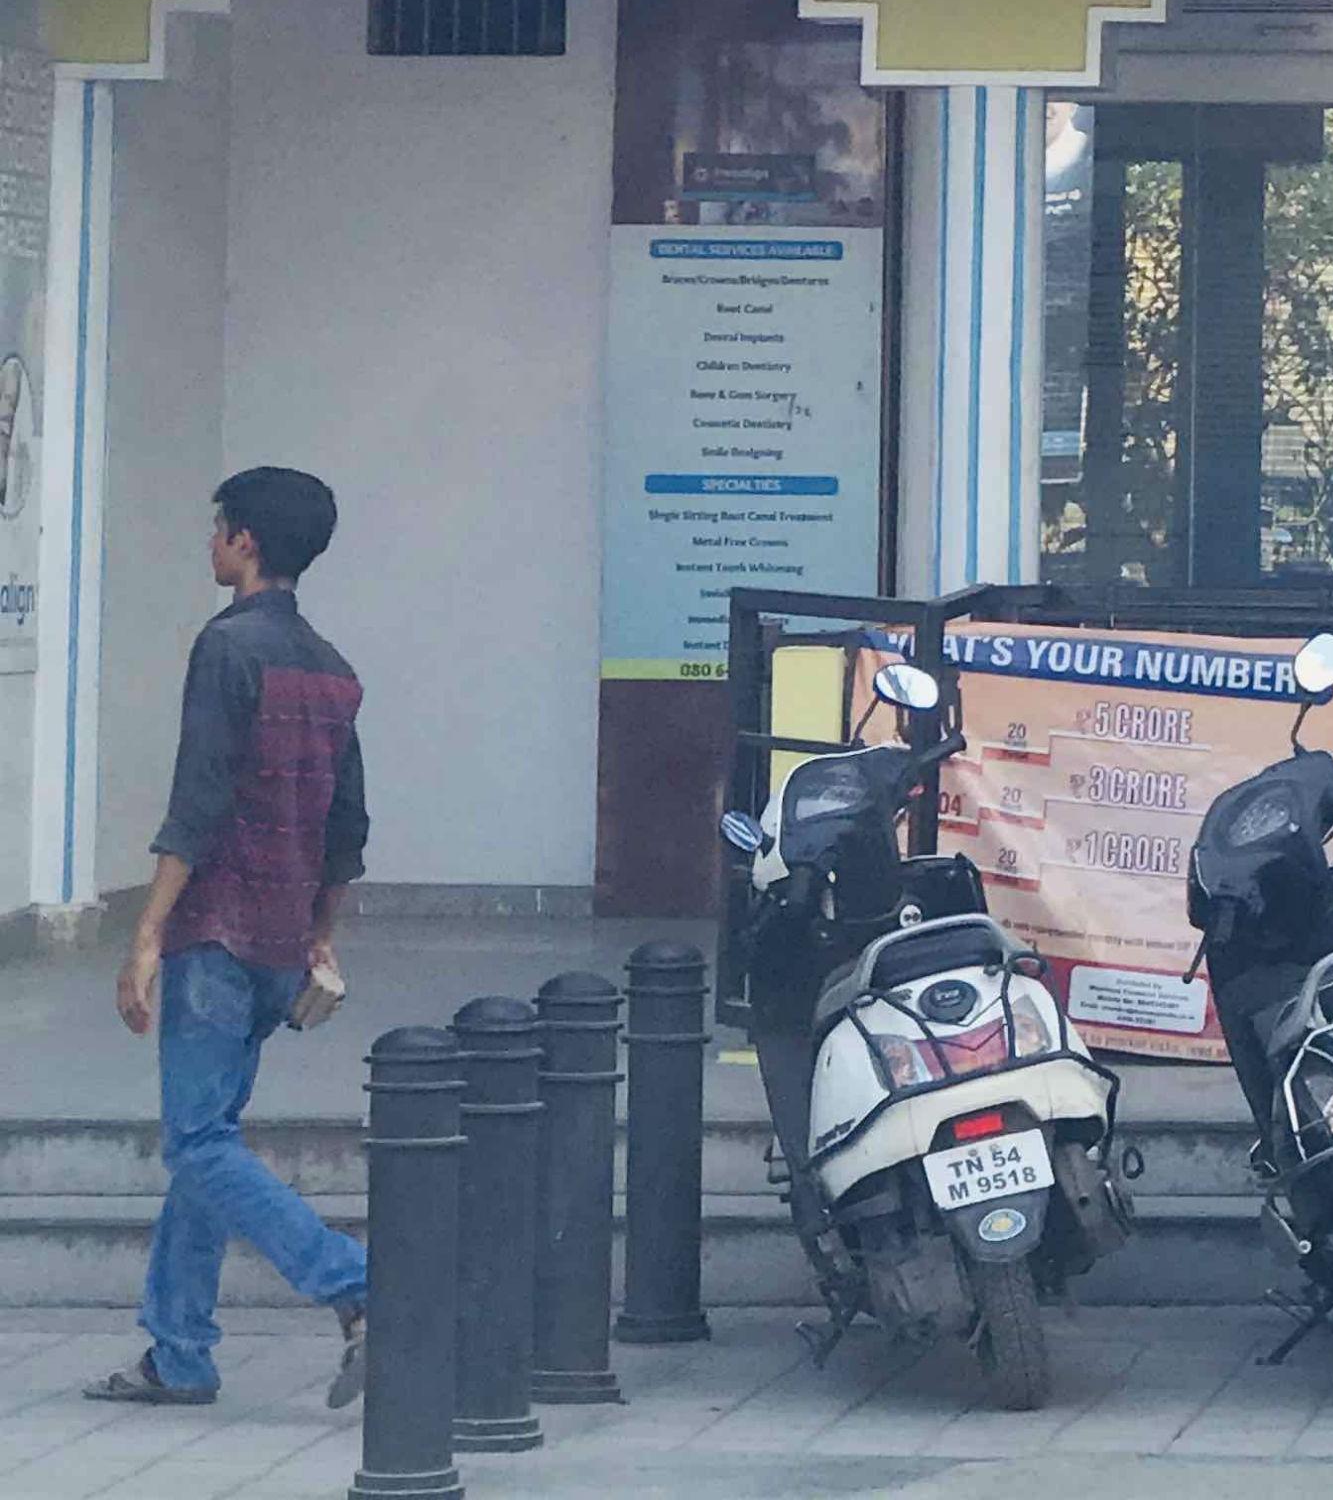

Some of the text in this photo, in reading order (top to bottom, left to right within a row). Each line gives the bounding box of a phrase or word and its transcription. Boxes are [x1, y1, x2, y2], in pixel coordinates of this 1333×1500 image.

[1027, 639, 1123, 679] YOUR
[1135, 649, 1297, 695] NUMBER
[1007, 722, 1027, 739] 20
[1095, 702, 1194, 744] 5 CRORE
[1002, 785, 1023, 802] 20
[1088, 766, 1187, 809] 3 CRORE
[1085, 829, 1181, 874] 1 CRORE
[947, 1145, 1023, 1179] TN 54
[947, 1166, 1038, 1202] M 9518
